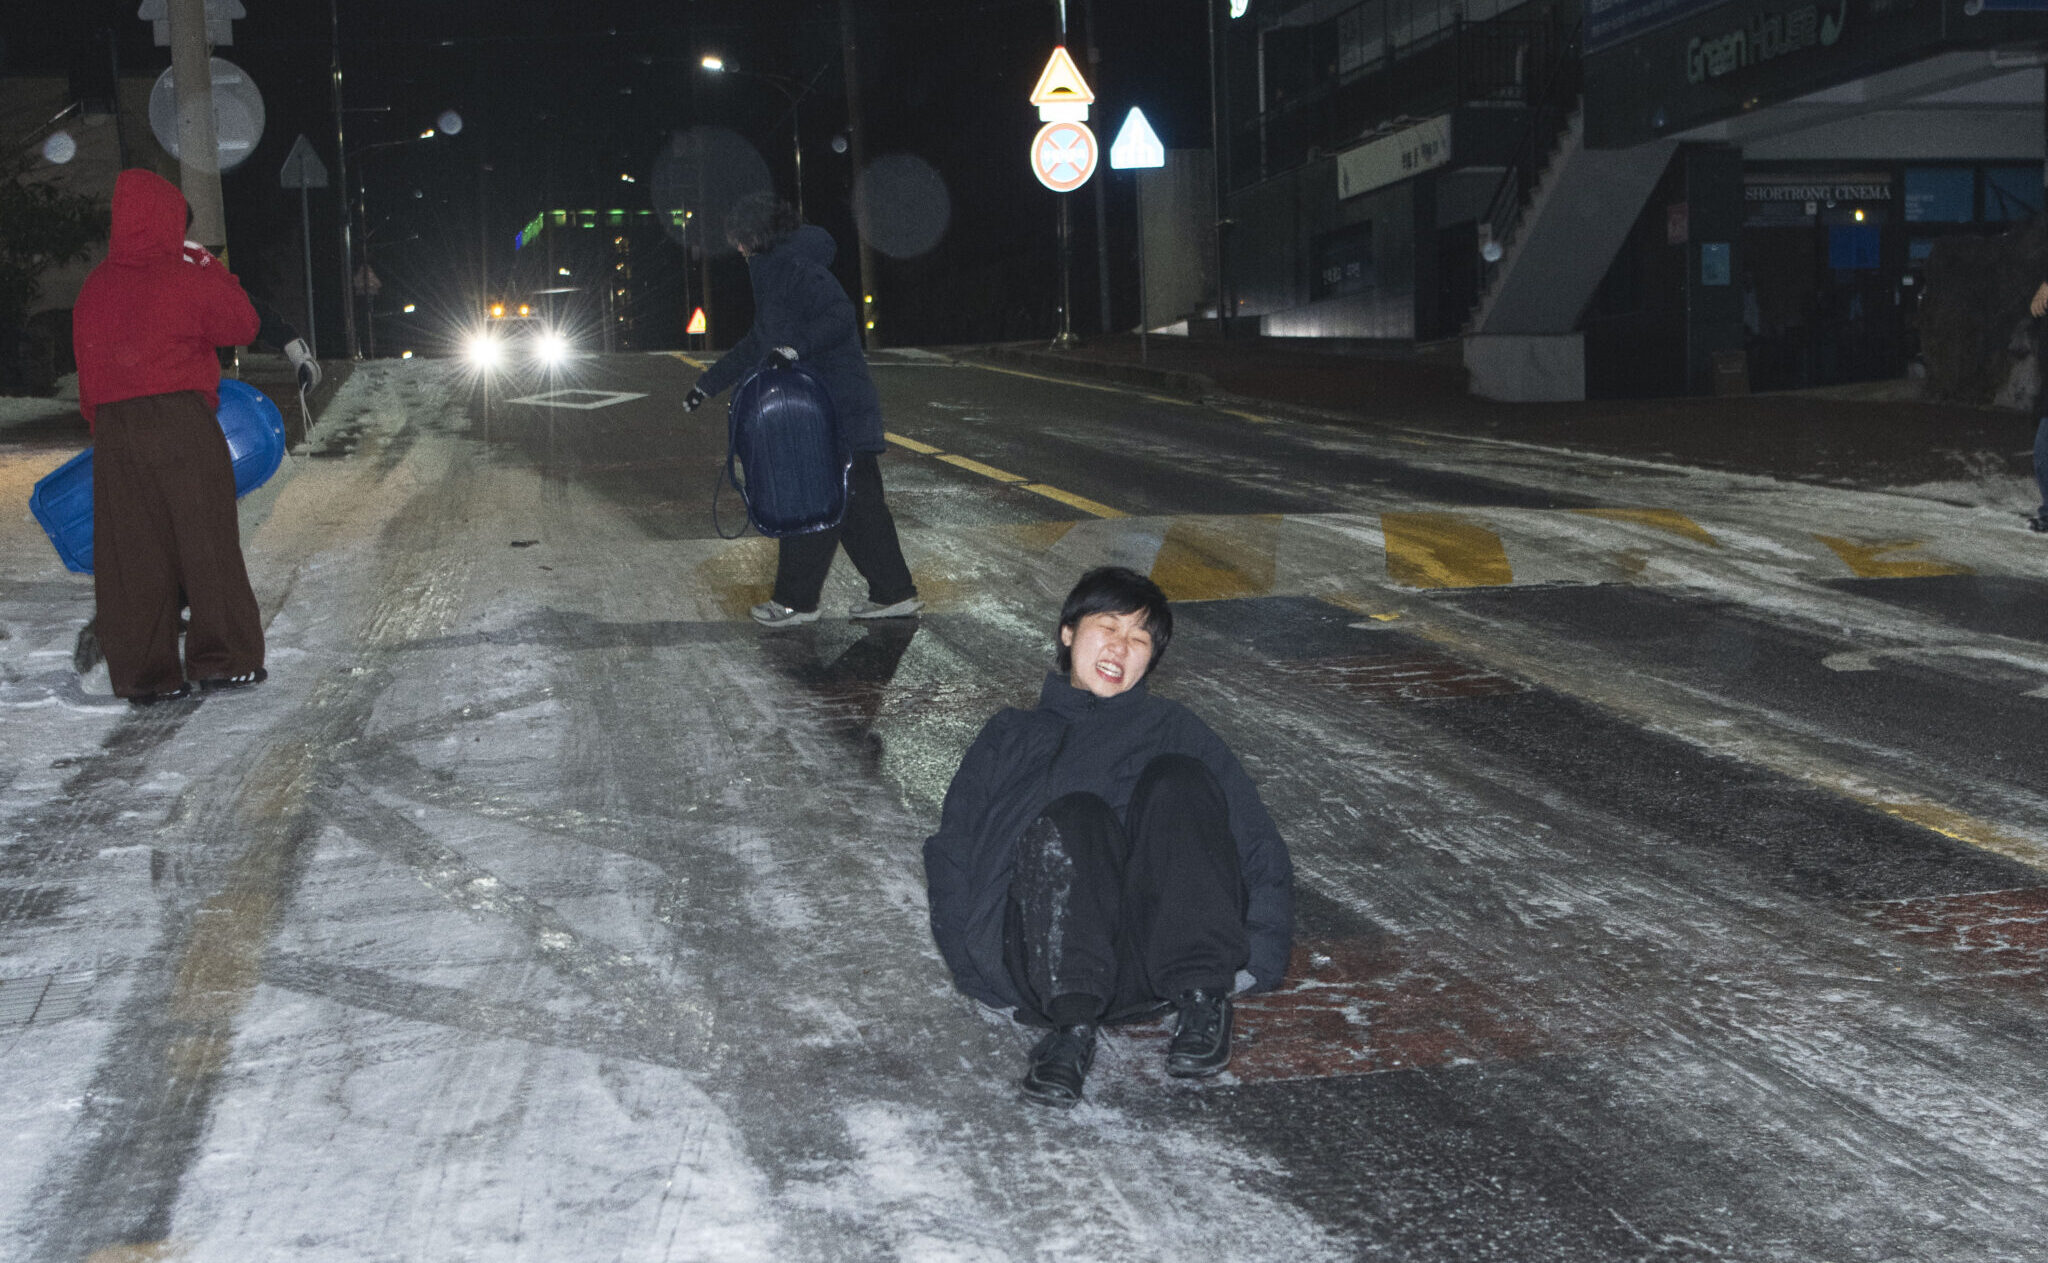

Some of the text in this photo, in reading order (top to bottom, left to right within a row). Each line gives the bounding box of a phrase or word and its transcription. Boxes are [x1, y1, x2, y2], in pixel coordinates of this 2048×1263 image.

[1687, 5, 1816, 84] Green House
[1835, 185, 1891, 200] CINEMA
